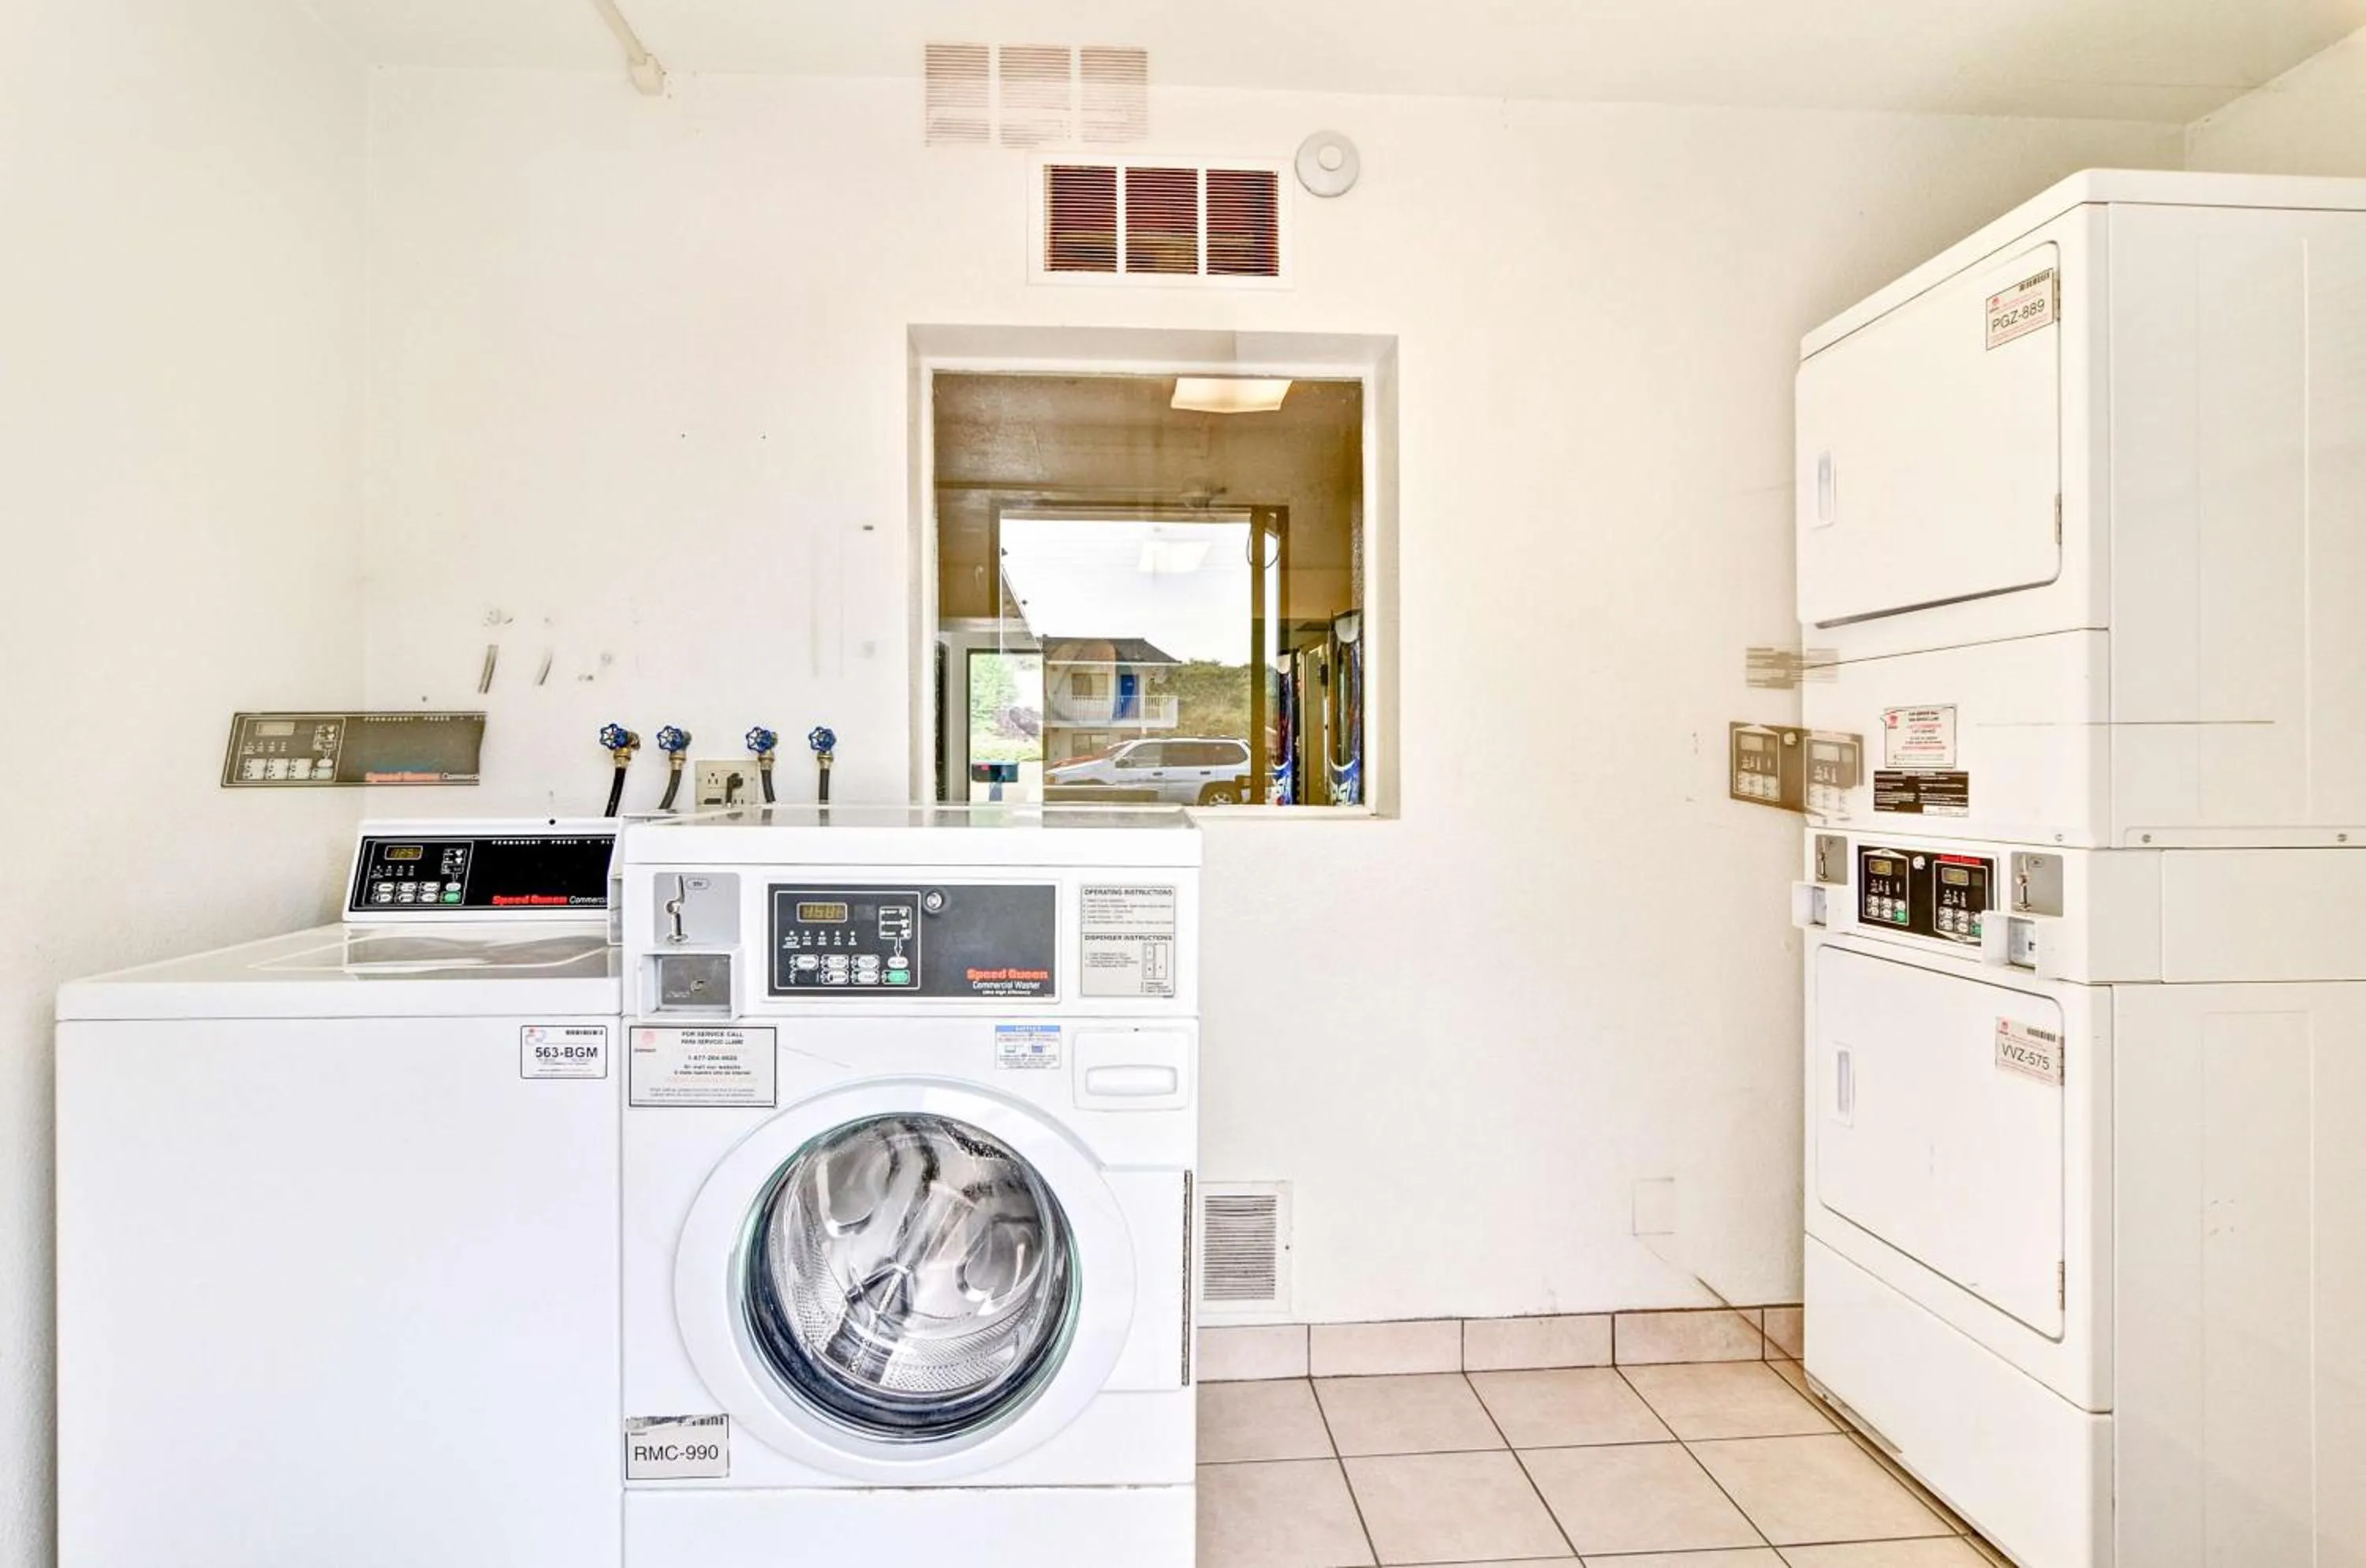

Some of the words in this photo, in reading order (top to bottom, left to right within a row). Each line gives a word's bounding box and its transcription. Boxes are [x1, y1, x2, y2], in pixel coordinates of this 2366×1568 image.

[1992, 299, 2045, 332] PGZ-889
[492, 895, 529, 905] Speed
[966, 969, 1007, 980] Speed
[1008, 969, 1048, 980] Queen
[972, 980, 1013, 989] Commercial
[536, 1047, 598, 1058] 563-BGM
[634, 1444, 718, 1461] RMC-990
